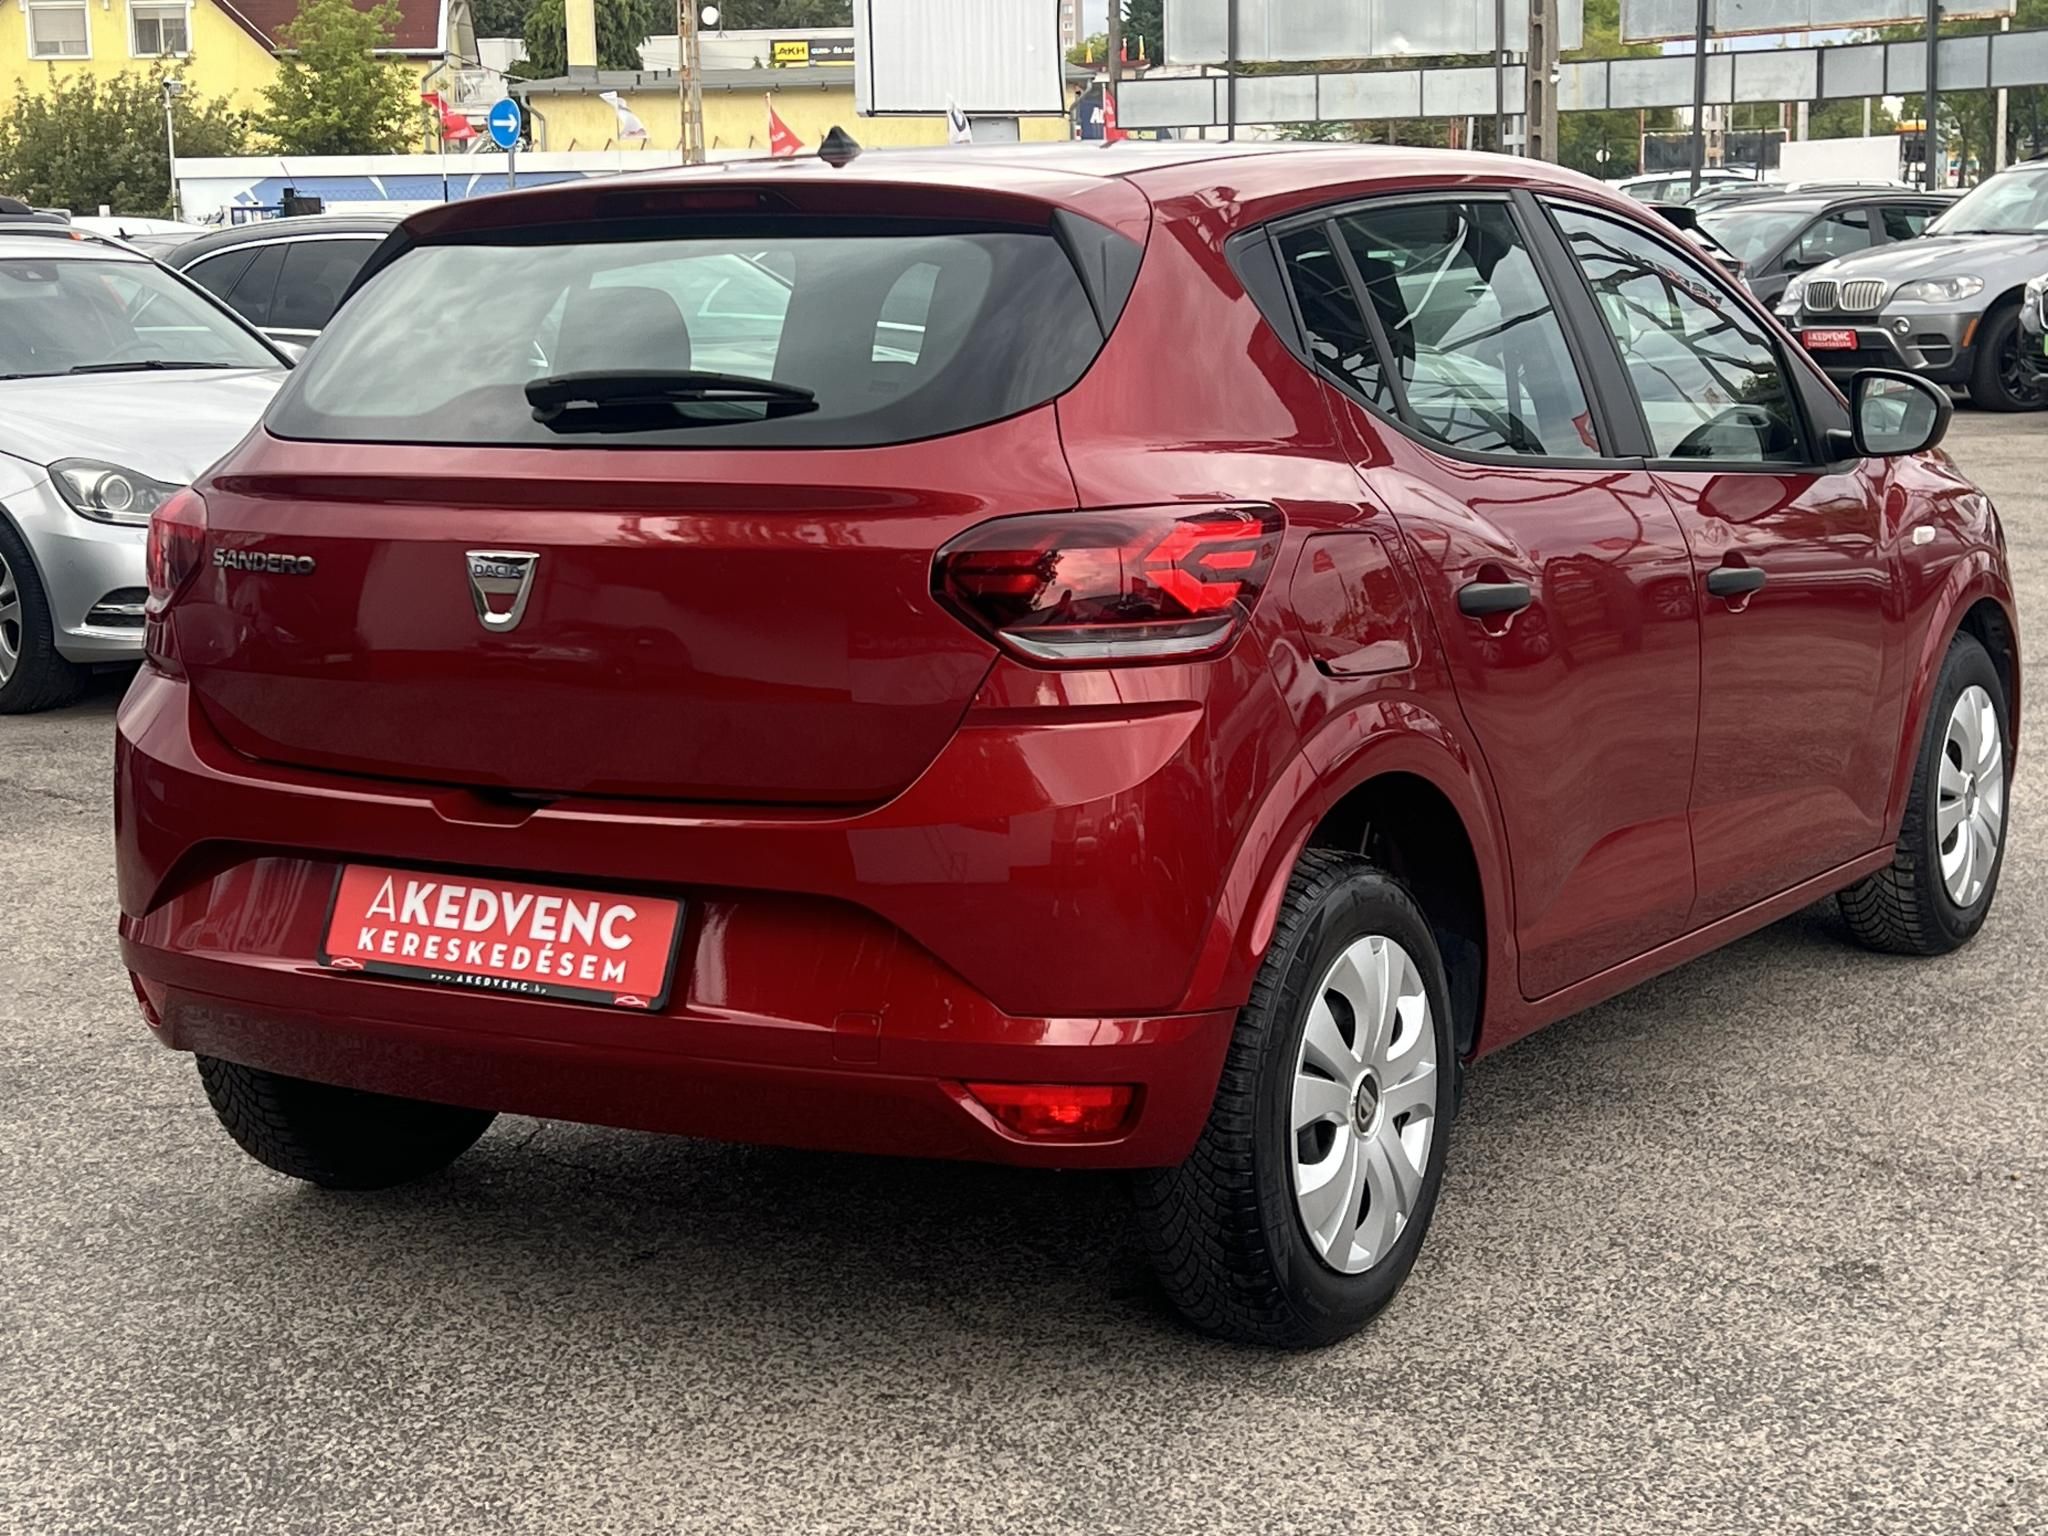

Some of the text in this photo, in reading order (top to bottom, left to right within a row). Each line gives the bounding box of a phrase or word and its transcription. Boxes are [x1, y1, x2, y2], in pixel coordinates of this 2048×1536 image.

[212, 548, 316, 575] SANDERO
[474, 564, 522, 577] DACIA
[356, 926, 627, 984] KERESKEDÉSEM
